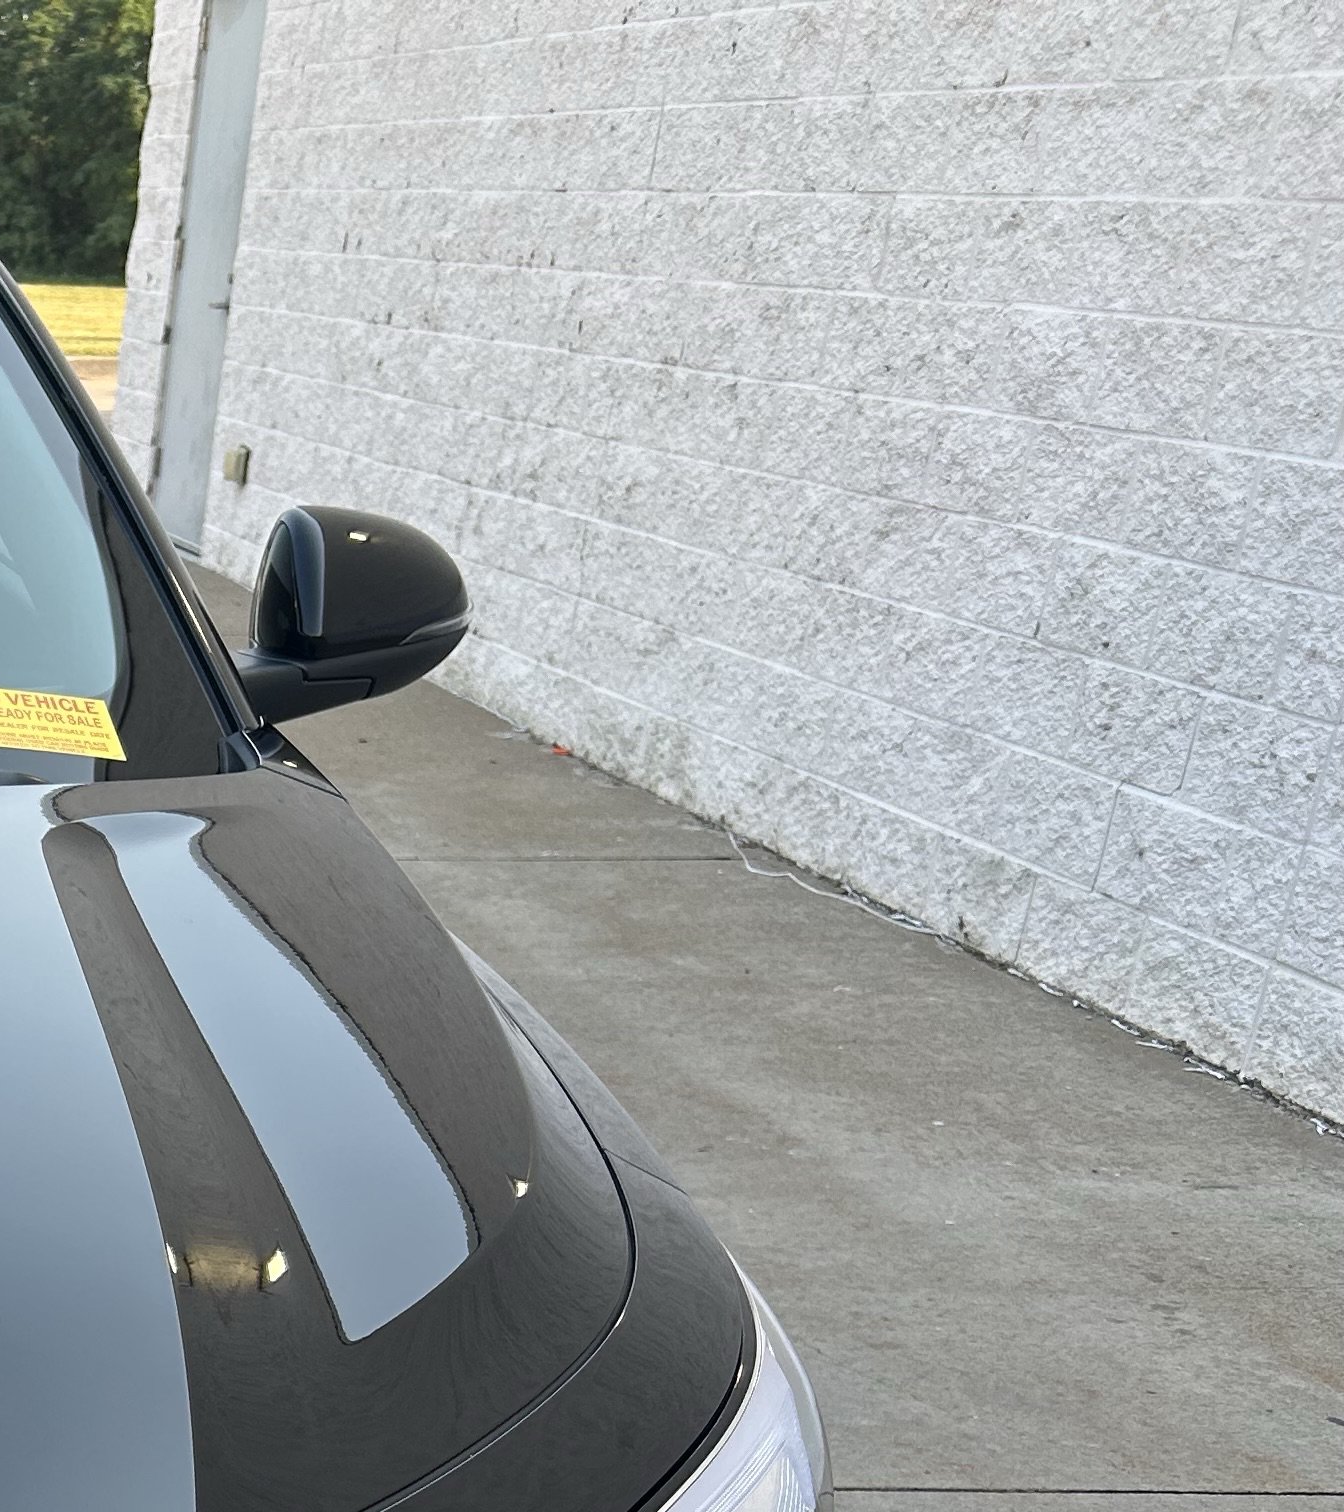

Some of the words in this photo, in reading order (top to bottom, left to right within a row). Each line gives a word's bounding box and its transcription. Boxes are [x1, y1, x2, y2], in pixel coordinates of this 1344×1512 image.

[5, 692, 99, 715] VEHICLE
[36, 712, 63, 724] FOR
[67, 715, 103, 729] SALE
